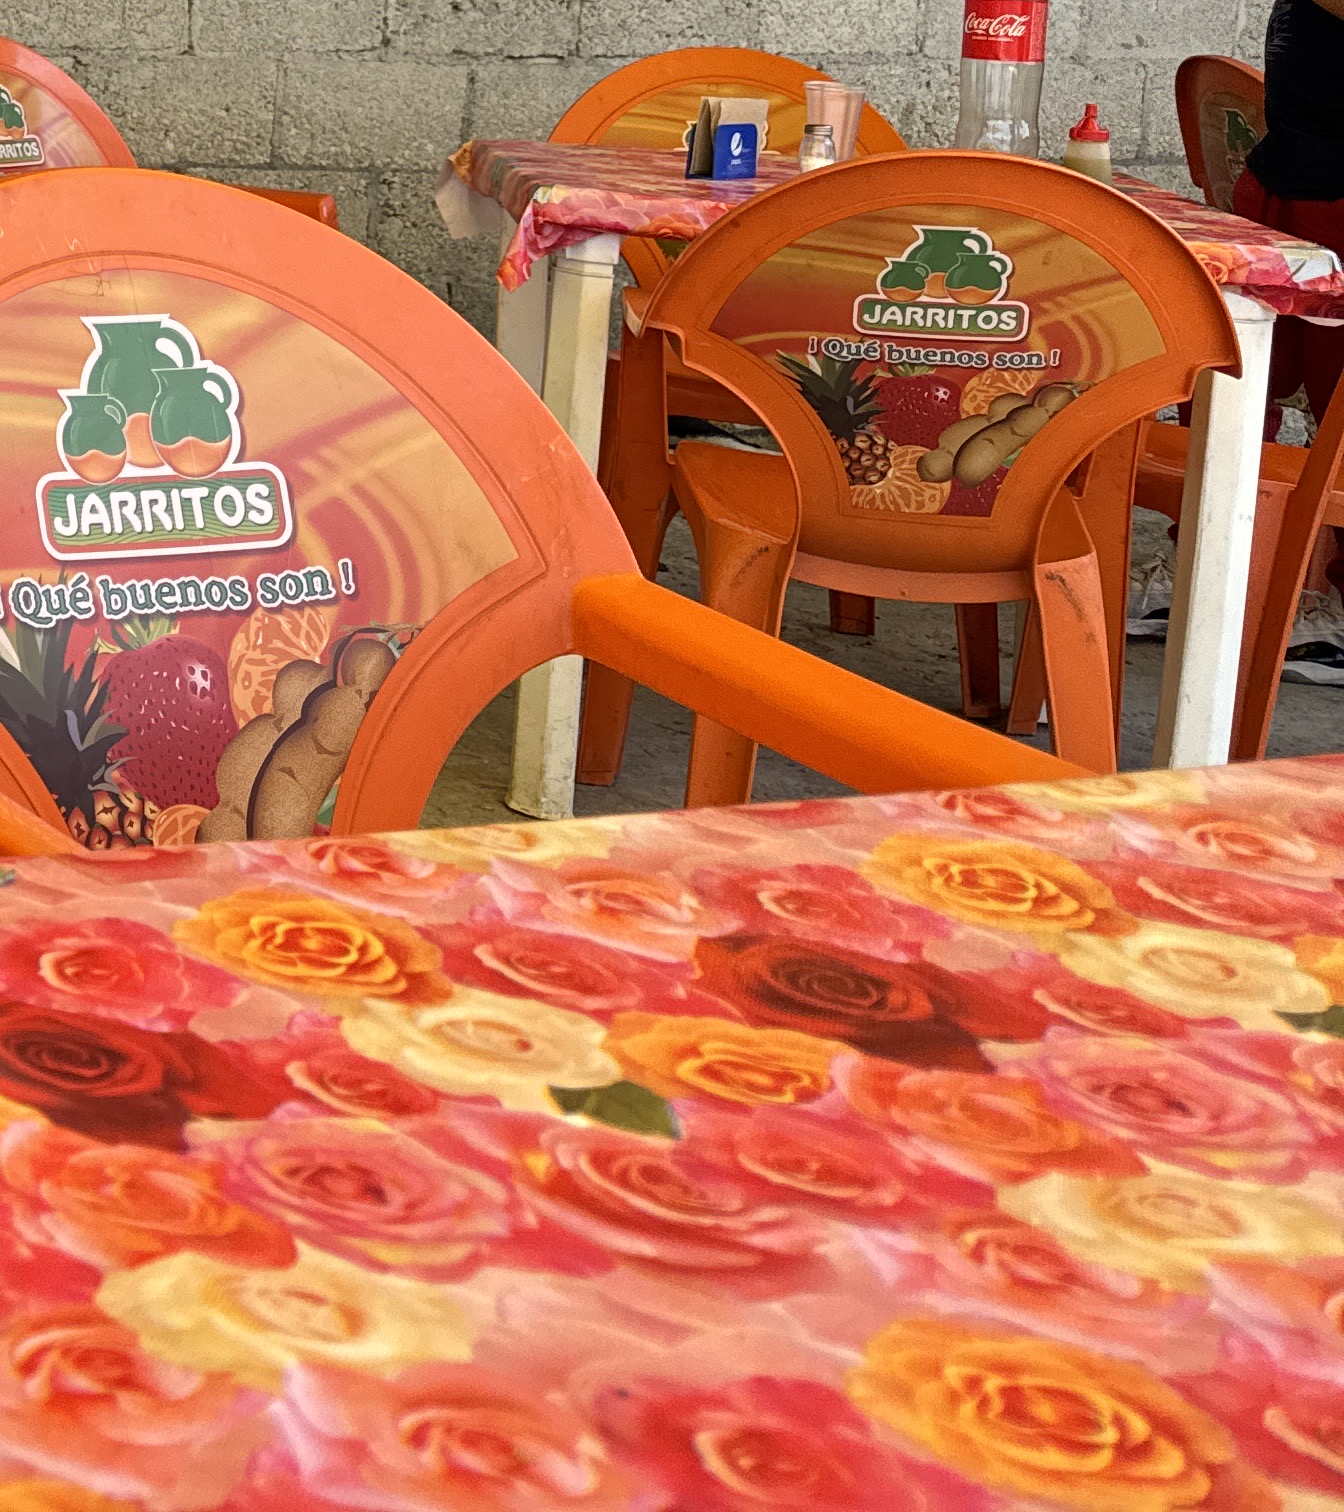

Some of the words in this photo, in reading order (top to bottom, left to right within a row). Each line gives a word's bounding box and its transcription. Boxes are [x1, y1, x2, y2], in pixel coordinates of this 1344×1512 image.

[863, 304, 1017, 330] JARRITOS
[824, 337, 880, 360] Qué
[886, 344, 989, 366] buenos
[994, 351, 1046, 369] son
[54, 484, 274, 537] JARRITOS
[9, 572, 94, 629] Qué
[101, 576, 249, 619] buenos
[257, 566, 334, 607] son
